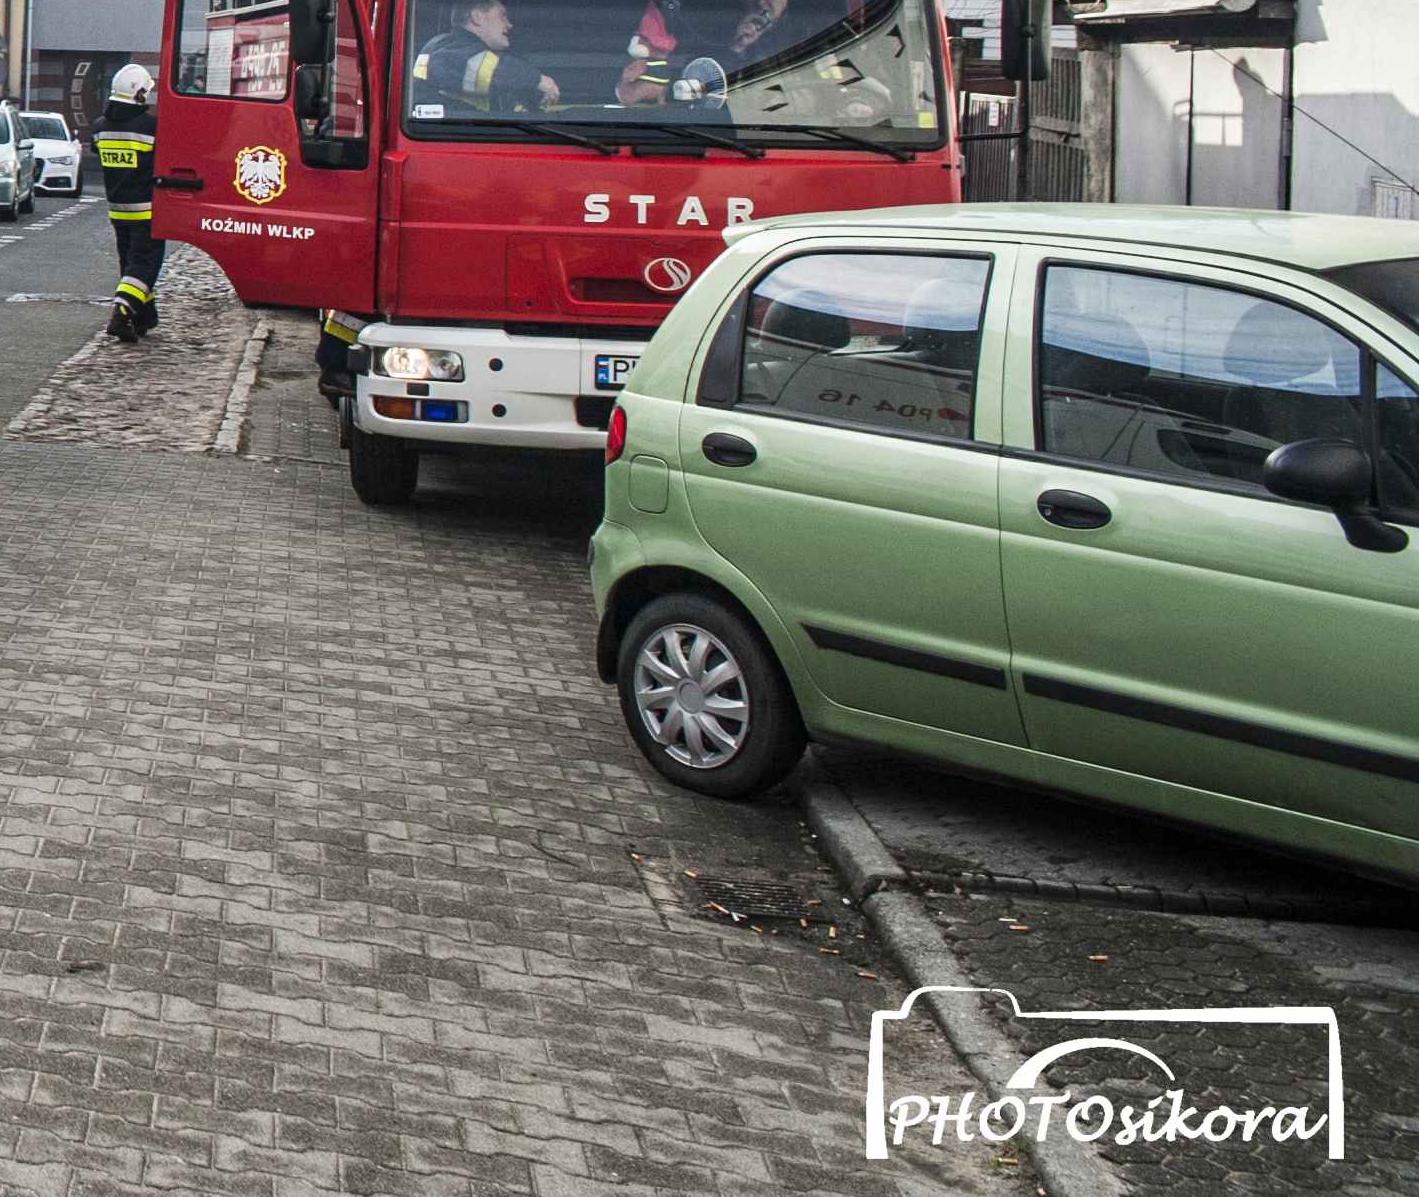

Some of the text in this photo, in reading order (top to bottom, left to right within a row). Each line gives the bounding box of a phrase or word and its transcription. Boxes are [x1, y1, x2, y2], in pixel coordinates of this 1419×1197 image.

[583, 193, 755, 227] STAR
[201, 217, 315, 240] KOŹMIN WLKP
